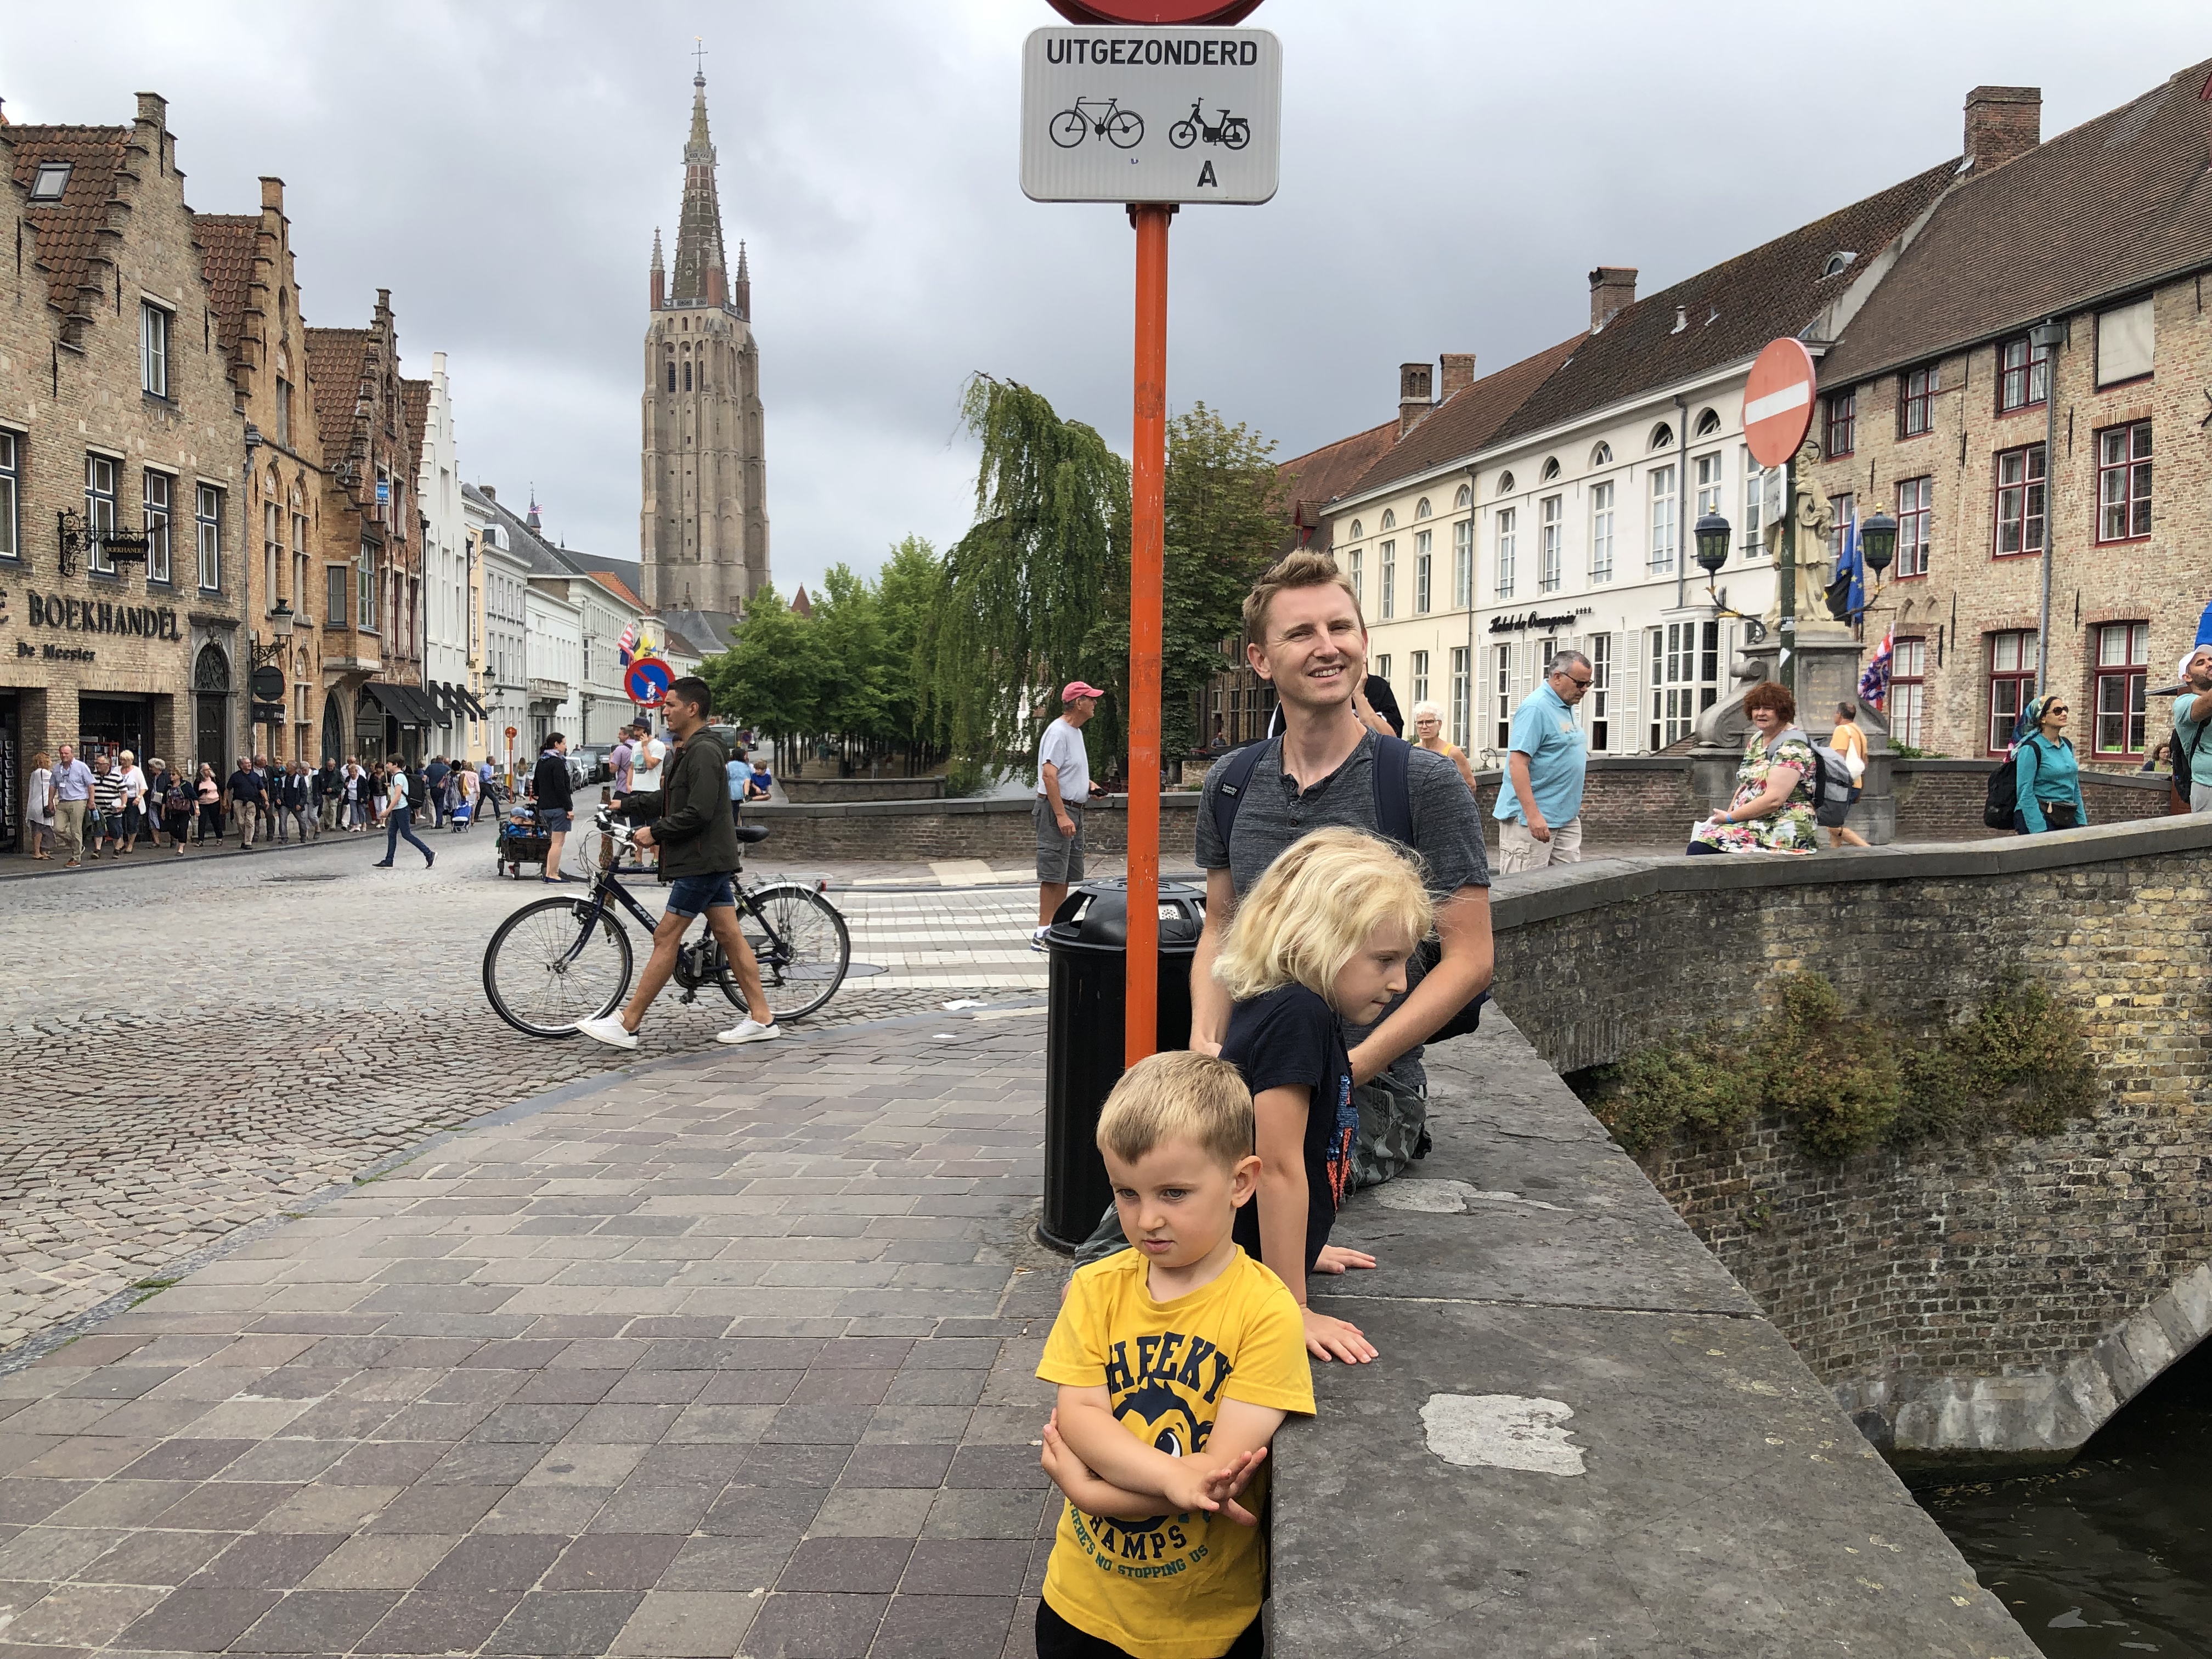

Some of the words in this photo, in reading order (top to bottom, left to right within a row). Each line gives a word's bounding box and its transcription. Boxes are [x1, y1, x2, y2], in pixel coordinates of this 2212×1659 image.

[1047, 39, 1257, 66] UITGEZONDERD
[1197, 160, 1218, 187] A
[29, 592, 182, 641] BOEKHANDEL
[18, 642, 35, 657] De
[1107, 1331, 1233, 1404] HEEKY
[1070, 1502, 1096, 1555] HERE'S
[1095, 1552, 1113, 1571] NO
[1118, 1558, 1186, 1578] STOPPING
[1188, 1544, 1208, 1562] US
[1090, 1516, 1187, 1560] HAMPS
